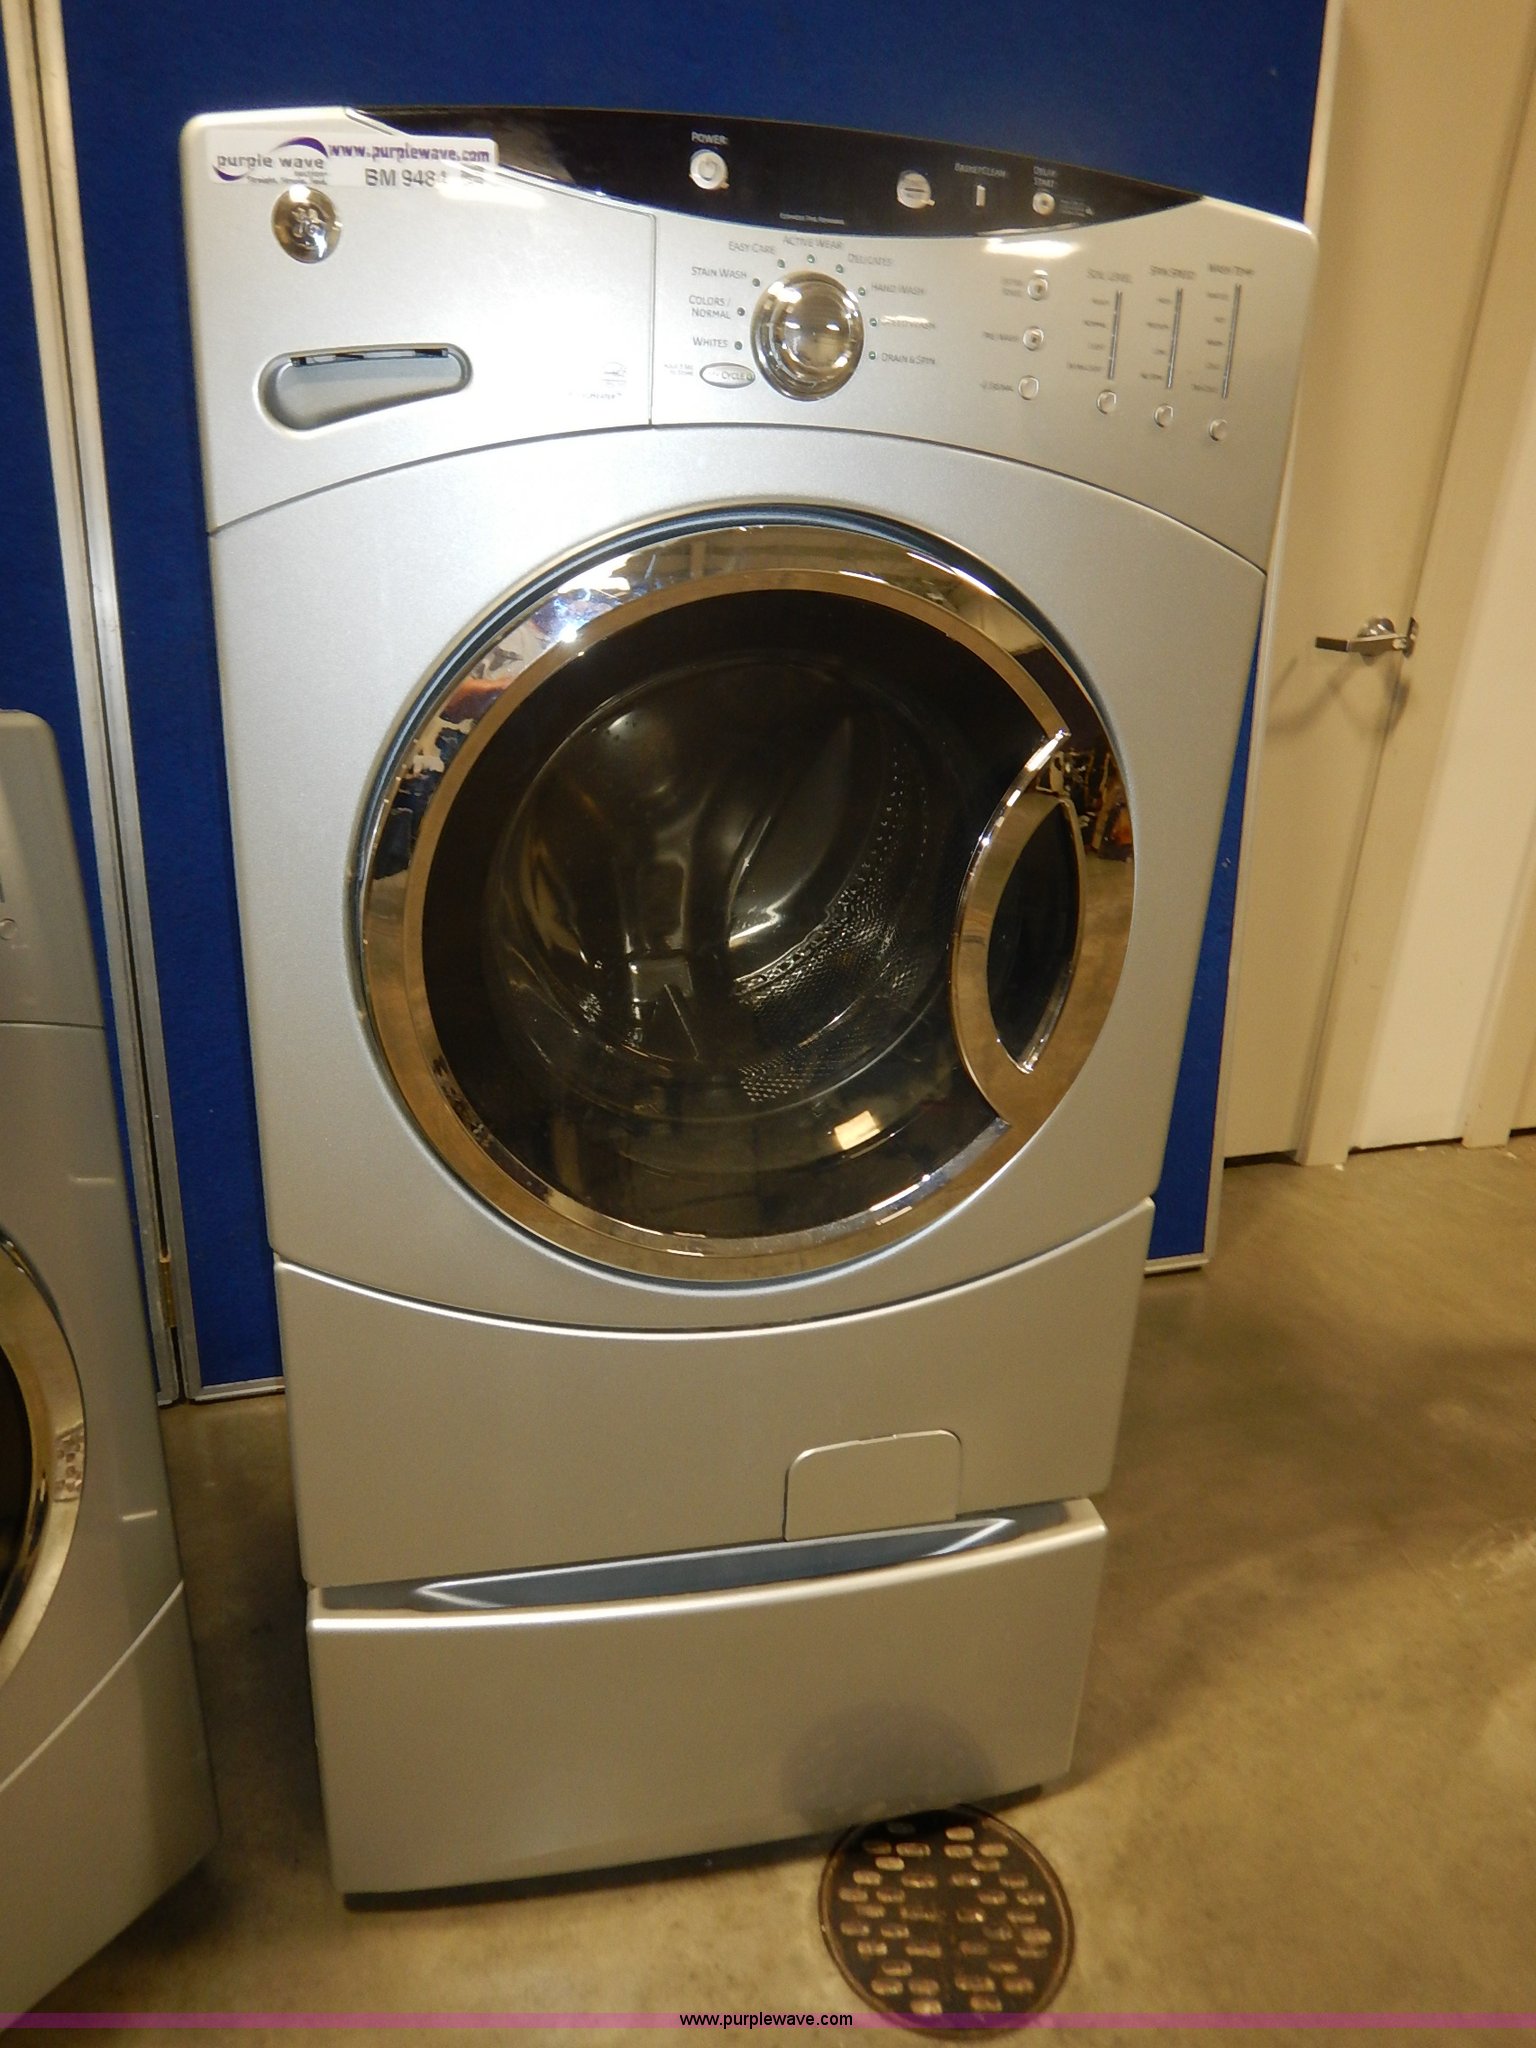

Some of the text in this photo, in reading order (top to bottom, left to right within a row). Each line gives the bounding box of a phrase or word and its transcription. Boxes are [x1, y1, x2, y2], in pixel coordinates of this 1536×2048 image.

[691, 131, 729, 145] POWER
[328, 142, 490, 162] www.purplewave.com
[217, 153, 325, 170] purple wave
[365, 168, 396, 187] BM
[691, 266, 747, 280] STAIN WASH
[691, 307, 731, 320] NORMAL
[692, 336, 729, 348] WHITES
